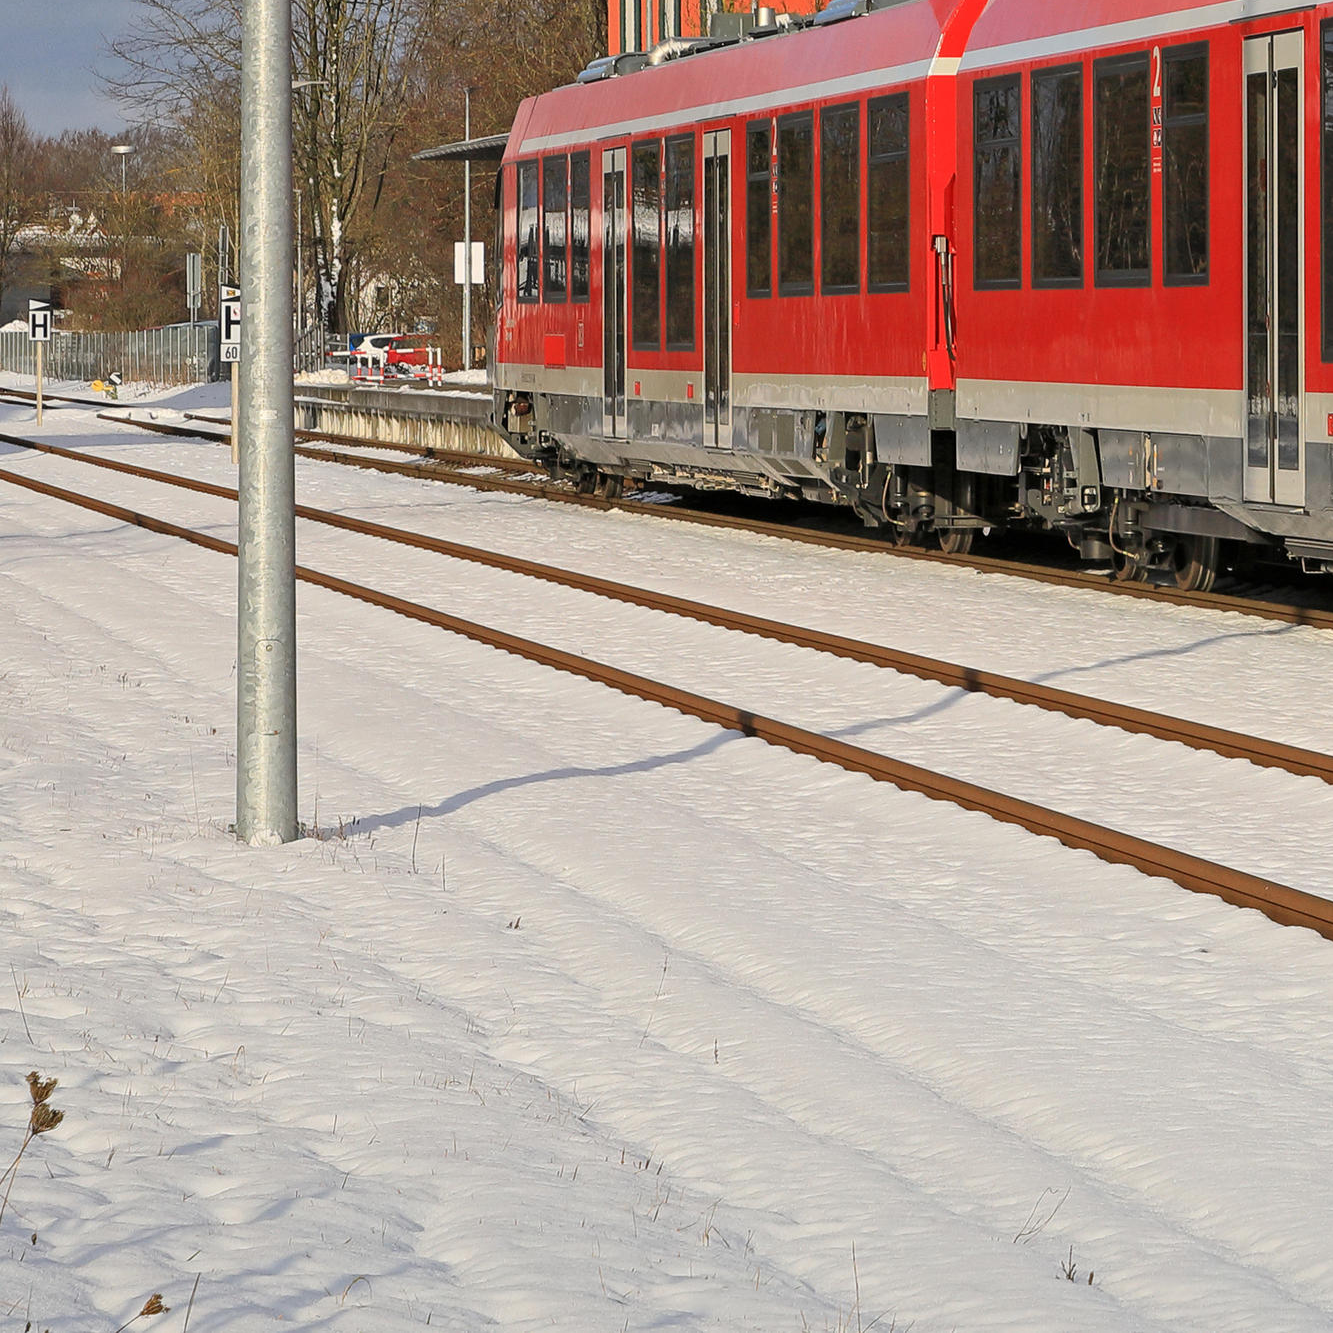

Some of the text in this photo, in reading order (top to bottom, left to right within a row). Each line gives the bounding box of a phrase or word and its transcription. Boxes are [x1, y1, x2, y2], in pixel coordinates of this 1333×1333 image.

[1153, 45, 1161, 97] 2
[31, 313, 48, 338] H
[225, 346, 238, 359] 60
